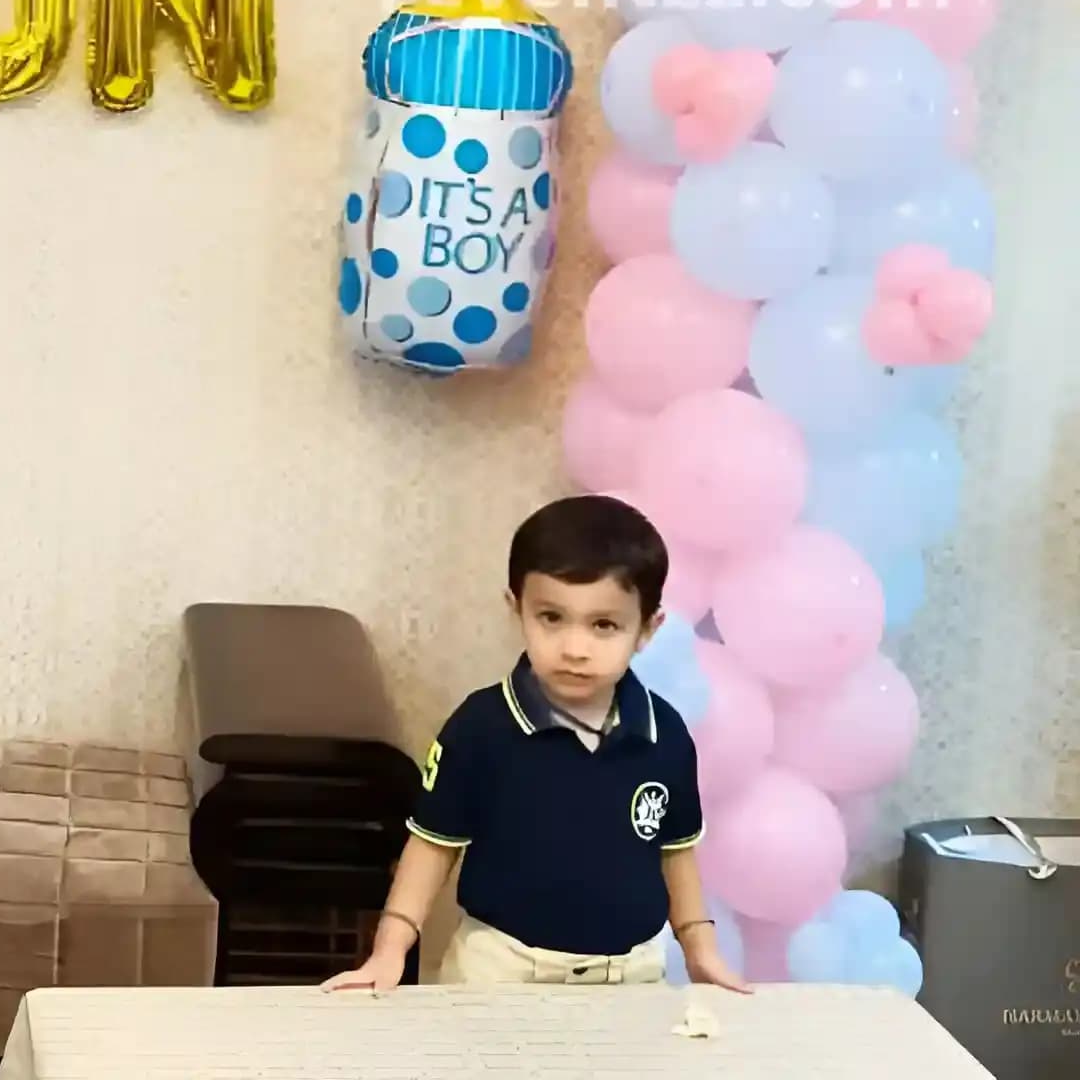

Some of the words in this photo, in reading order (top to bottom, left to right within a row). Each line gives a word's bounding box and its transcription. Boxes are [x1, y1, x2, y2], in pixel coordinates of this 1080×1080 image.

[420, 177, 492, 225] IT'S
[500, 187, 532, 227] A
[422, 223, 525, 273] BOY
